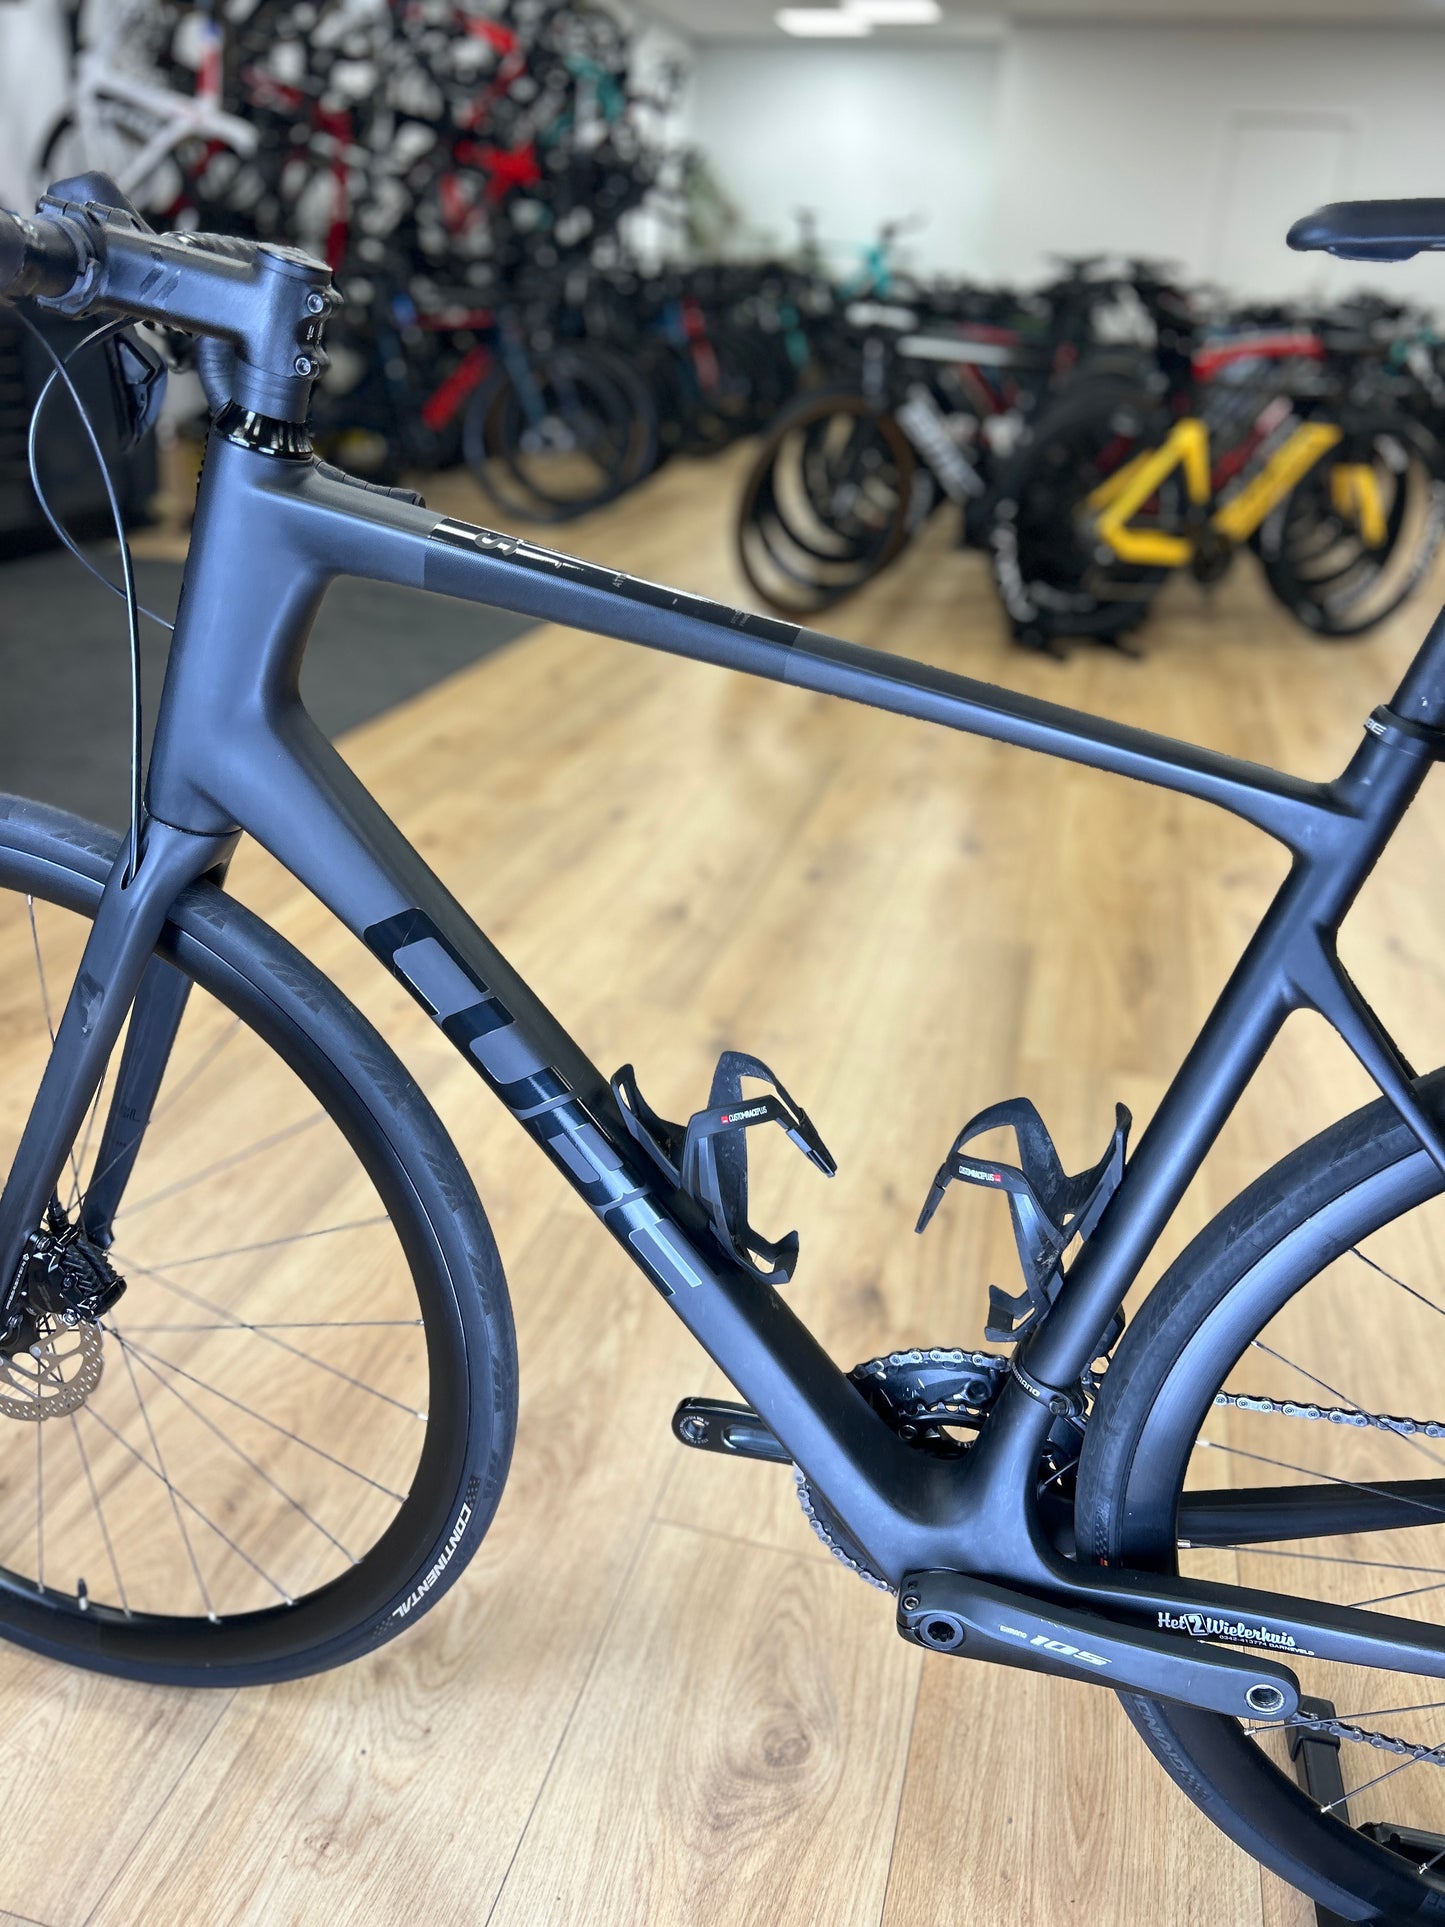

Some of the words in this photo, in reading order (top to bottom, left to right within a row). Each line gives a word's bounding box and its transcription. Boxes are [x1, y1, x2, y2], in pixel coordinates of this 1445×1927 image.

[392, 1502, 472, 1618] CONTINENTAL
[1157, 1611, 1187, 1630] Het
[1206, 1617, 1296, 1647] Wielerhuis
[1029, 1634, 1113, 1666] 105
